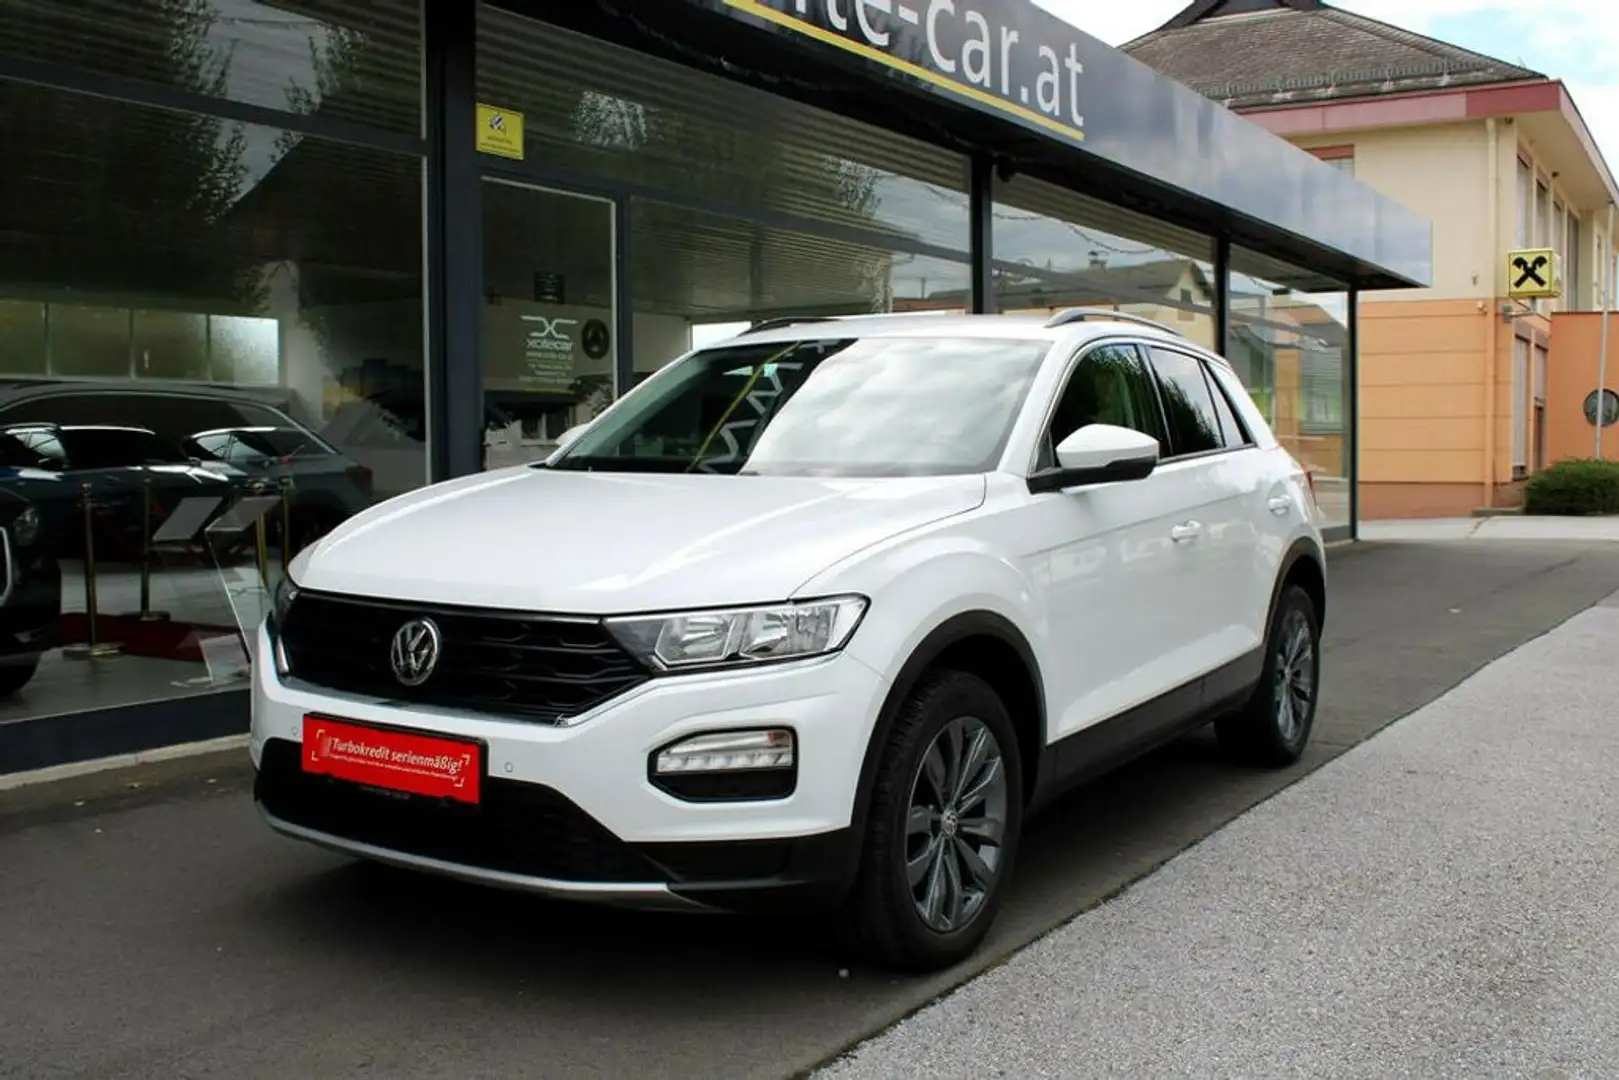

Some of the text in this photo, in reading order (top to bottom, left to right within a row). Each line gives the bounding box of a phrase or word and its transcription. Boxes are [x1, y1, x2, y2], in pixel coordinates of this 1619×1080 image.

[795, 0, 1084, 126] e-car.at
[331, 737, 390, 760] Turbokredit
[391, 750, 463, 775] serienmäßig!
